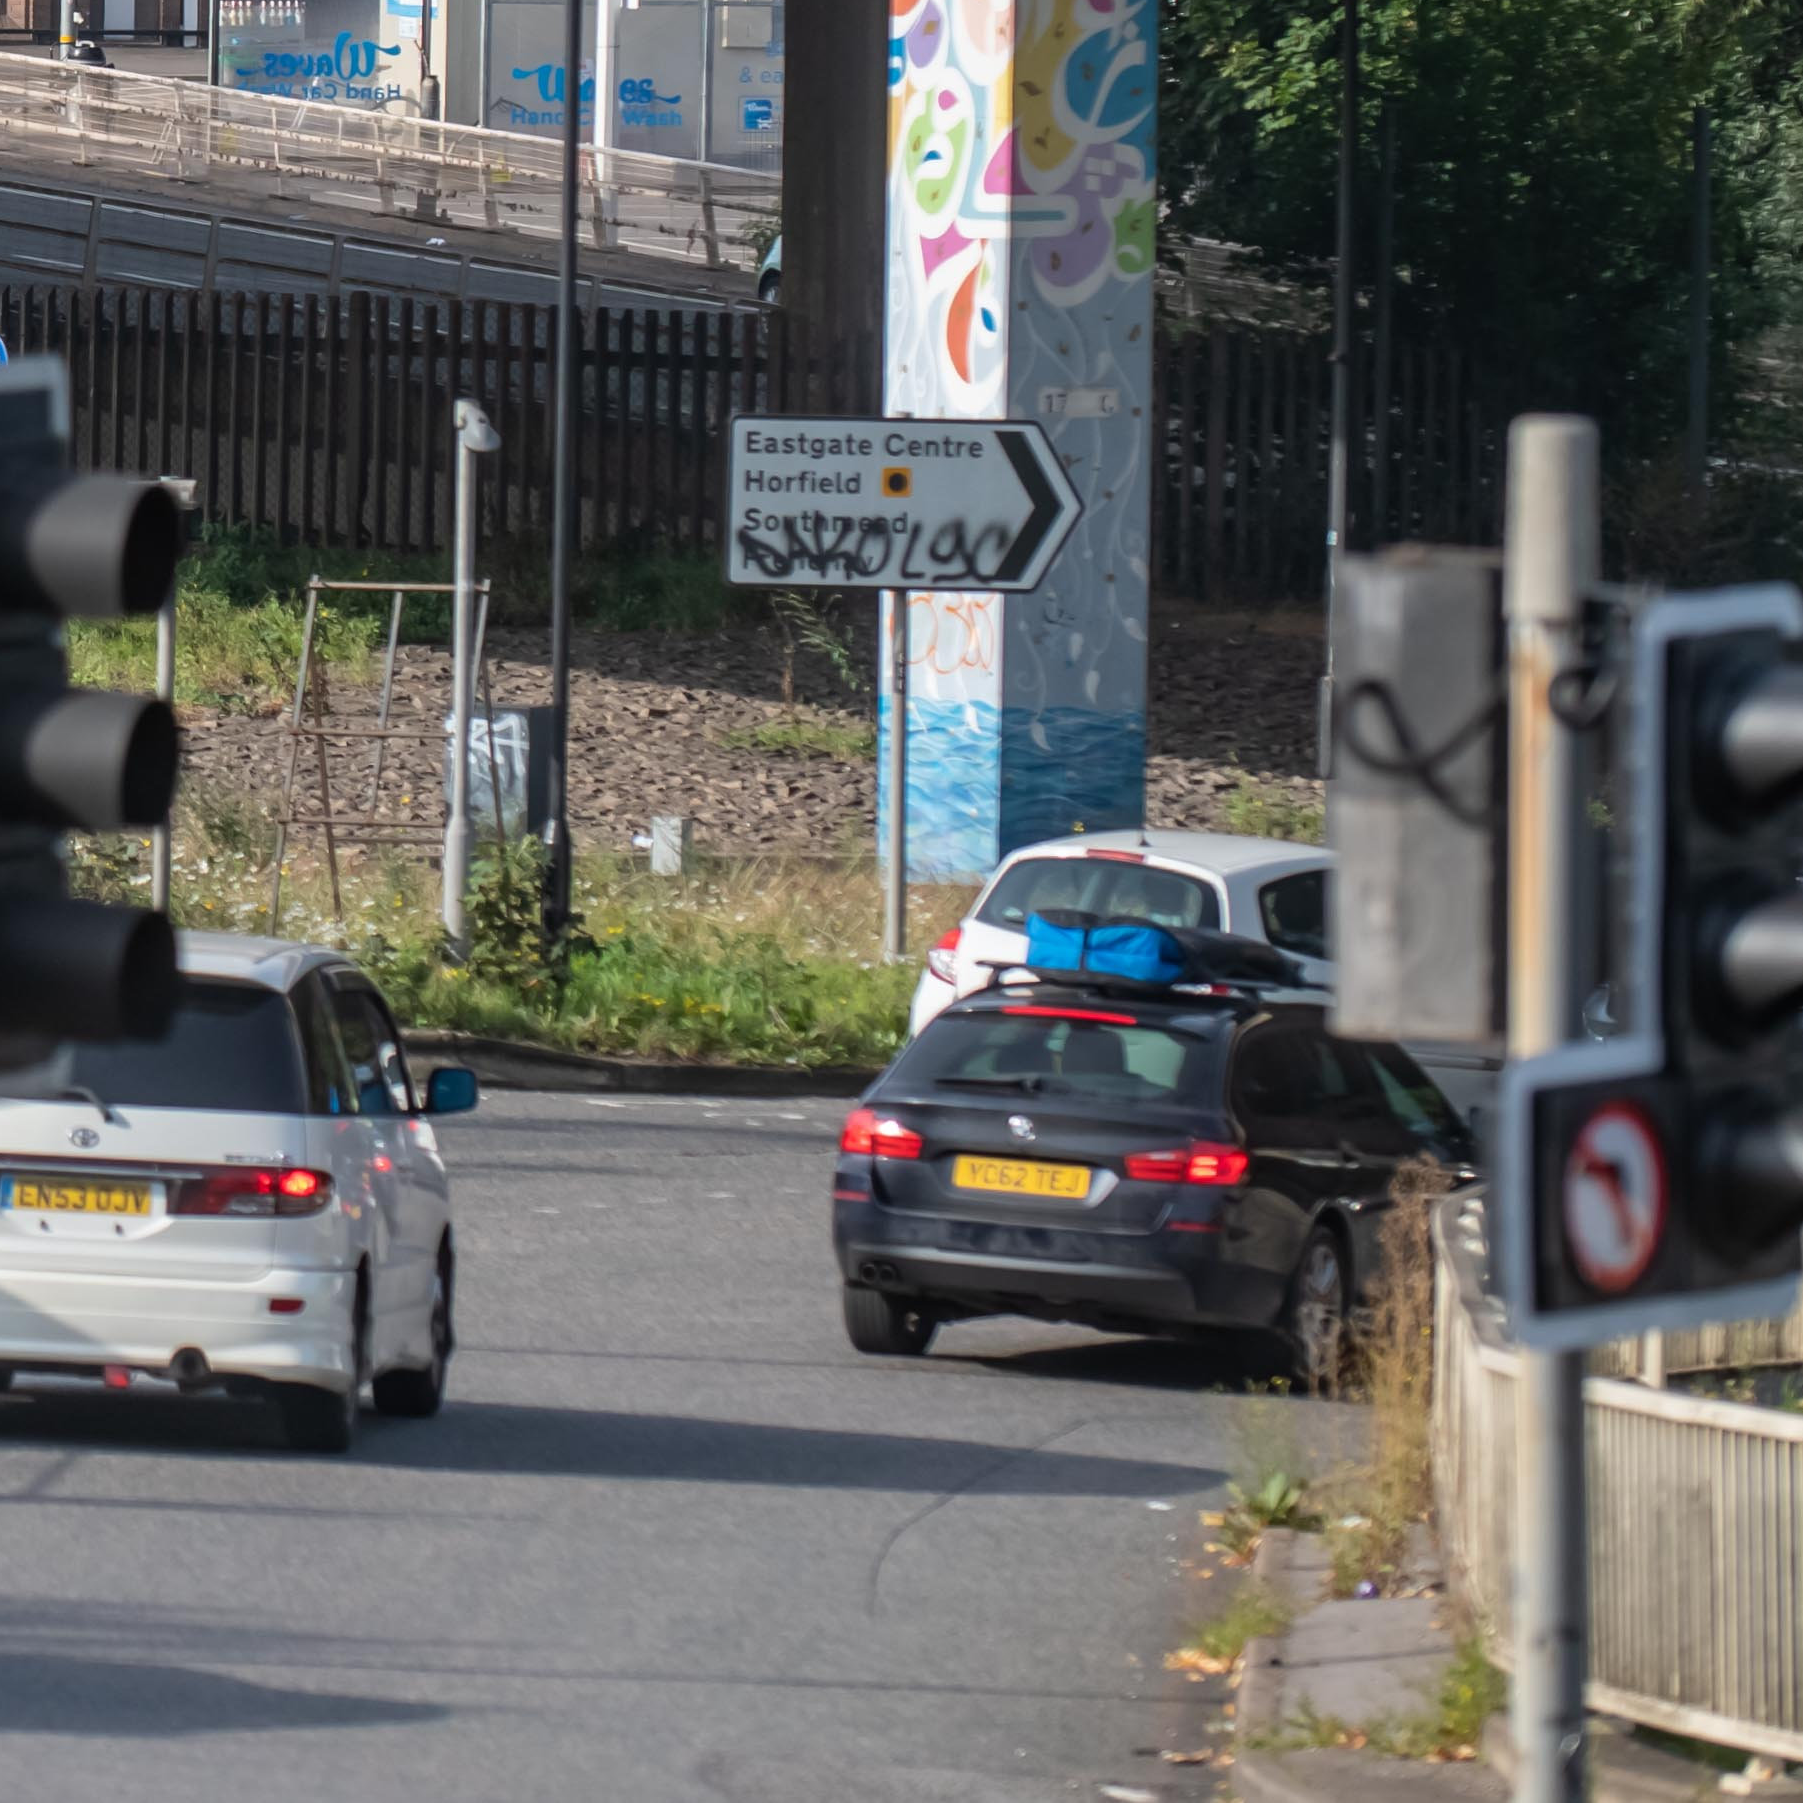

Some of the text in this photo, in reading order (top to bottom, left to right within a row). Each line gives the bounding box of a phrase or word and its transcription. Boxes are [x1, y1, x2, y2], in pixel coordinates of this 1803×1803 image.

[746, 431, 984, 459] Eastgate Centre
[744, 469, 862, 495] Horfield
[1036, 1168, 1081, 1192] TEJ
